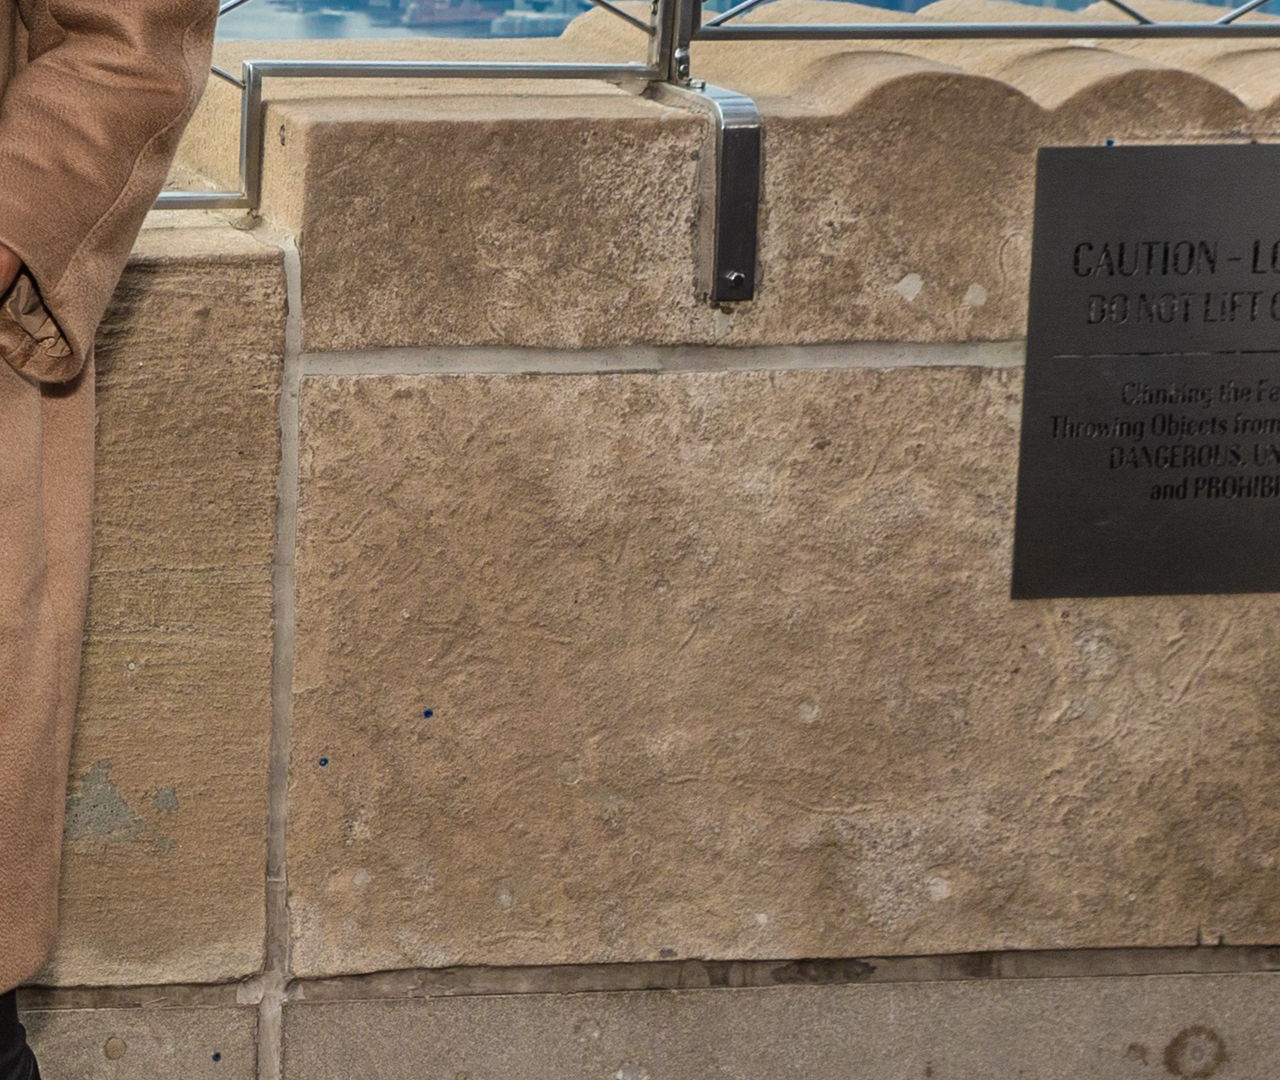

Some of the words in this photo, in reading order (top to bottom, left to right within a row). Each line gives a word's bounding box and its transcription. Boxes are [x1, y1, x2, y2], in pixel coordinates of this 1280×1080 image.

[1073, 239, 1218, 278] CAUTION
[1088, 293, 1130, 325] DO
[1139, 292, 1197, 324] NOT
[1203, 290, 1265, 323] LIFT
[1121, 381, 1213, 409] Climbing
[1218, 380, 1252, 403] the
[1050, 414, 1145, 443] Throwing
[1150, 412, 1228, 441] Objects
[1150, 477, 1189, 501] and
